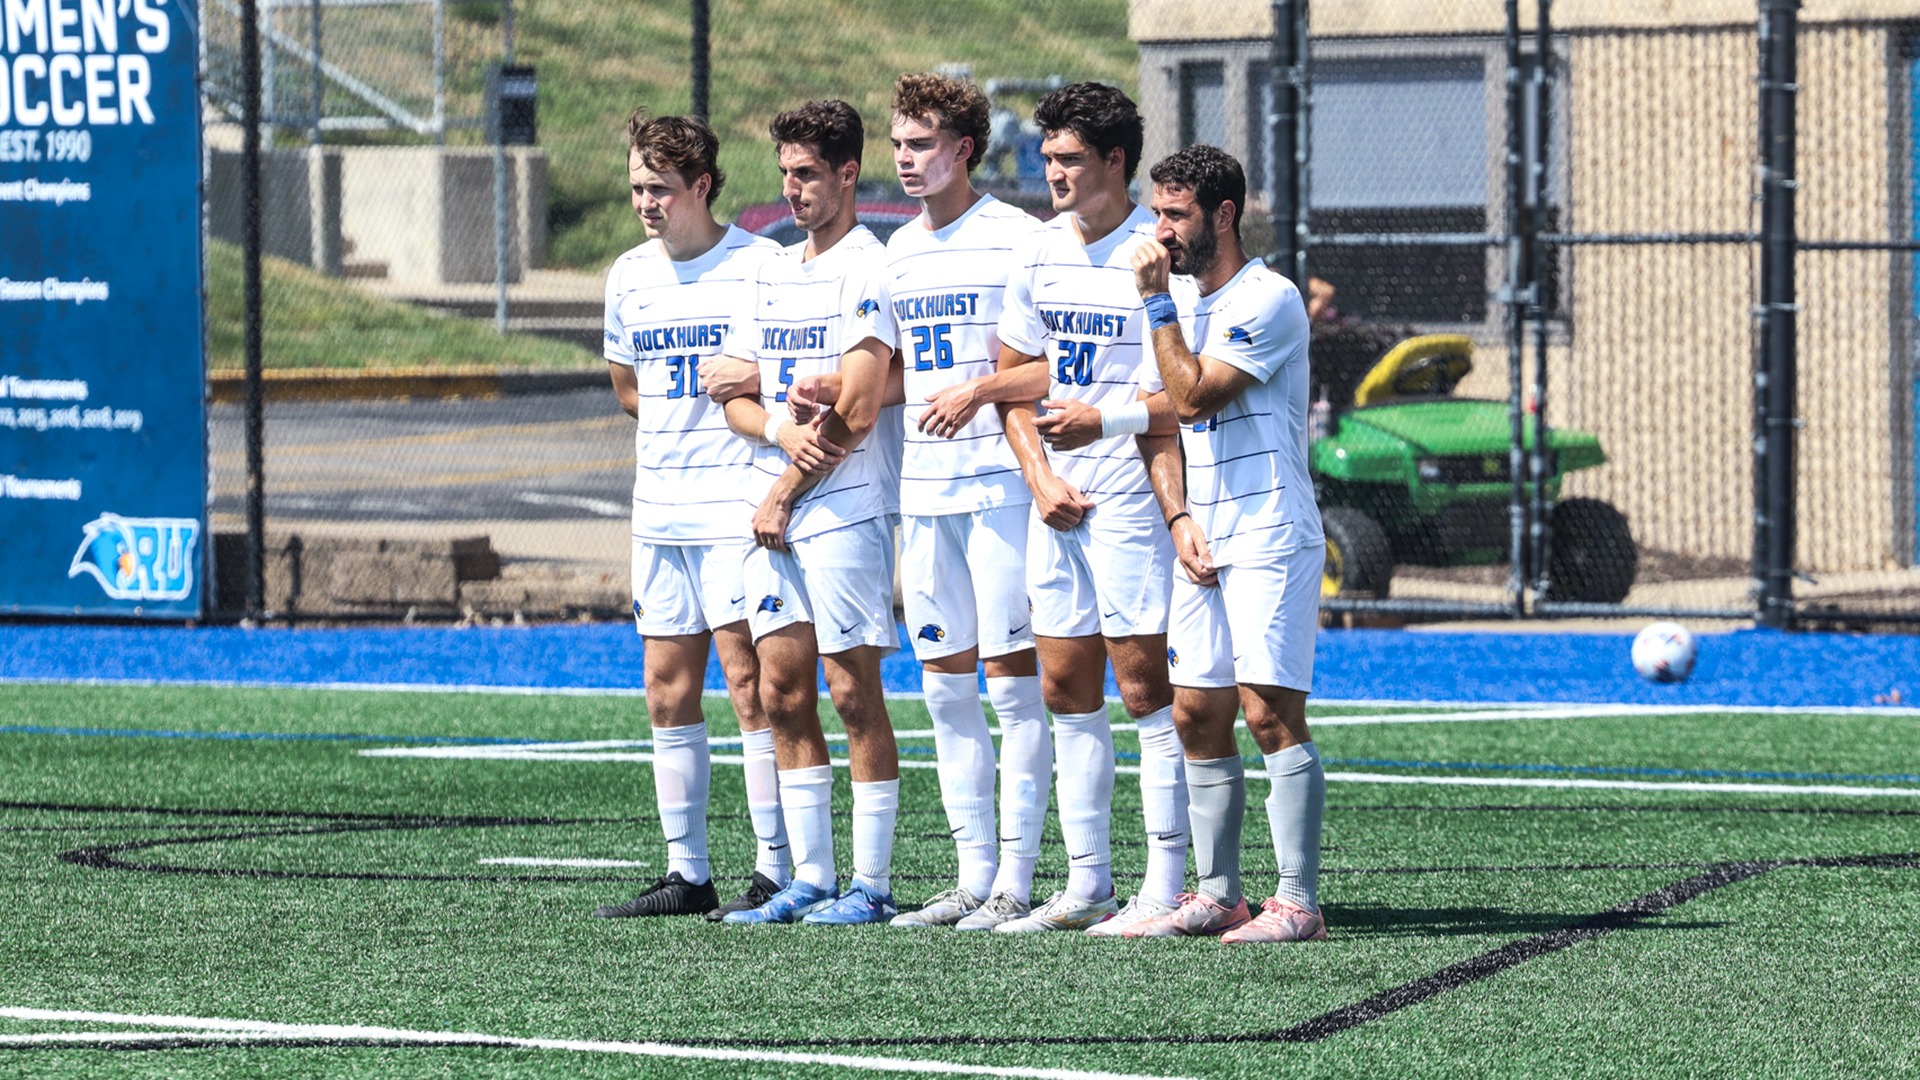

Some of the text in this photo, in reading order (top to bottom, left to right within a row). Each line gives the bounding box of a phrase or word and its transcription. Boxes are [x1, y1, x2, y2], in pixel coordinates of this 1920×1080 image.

[0, 0, 170, 53] MEN'S
[0, 129, 92, 162] EST. 1990
[24, 177, 91, 206] Champions
[43, 277, 109, 305] Champions
[761, 326, 827, 351] OCKHUST
[911, 323, 953, 372] 26
[666, 353, 699, 399] 31
[775, 357, 797, 402] 5
[1057, 340, 1096, 387] 20
[9, 376, 89, 401] Tournaments
[6, 474, 81, 500] Tournaments
